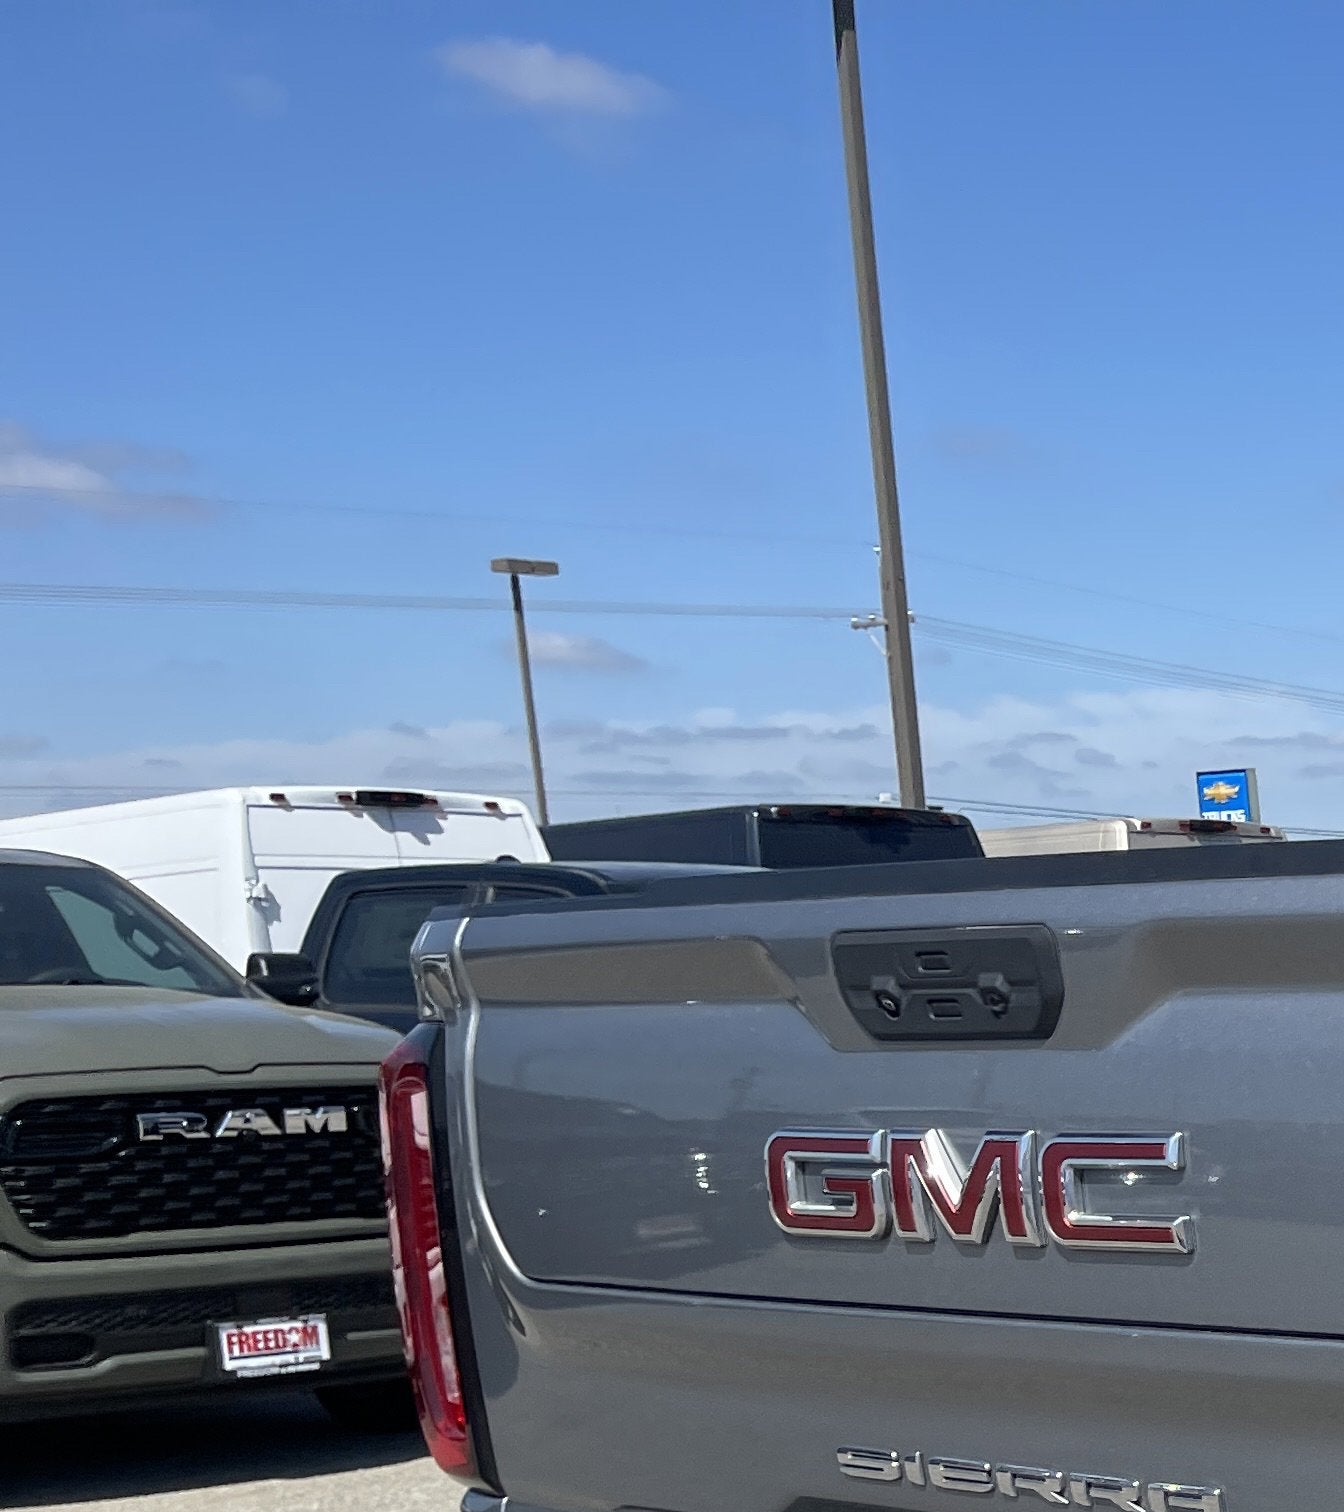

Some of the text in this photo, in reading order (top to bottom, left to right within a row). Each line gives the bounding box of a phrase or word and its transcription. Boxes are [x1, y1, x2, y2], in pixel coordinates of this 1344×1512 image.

[137, 1106, 348, 1141] RAM
[765, 1128, 1196, 1254] GMC
[227, 1325, 319, 1355] FREEDOM
